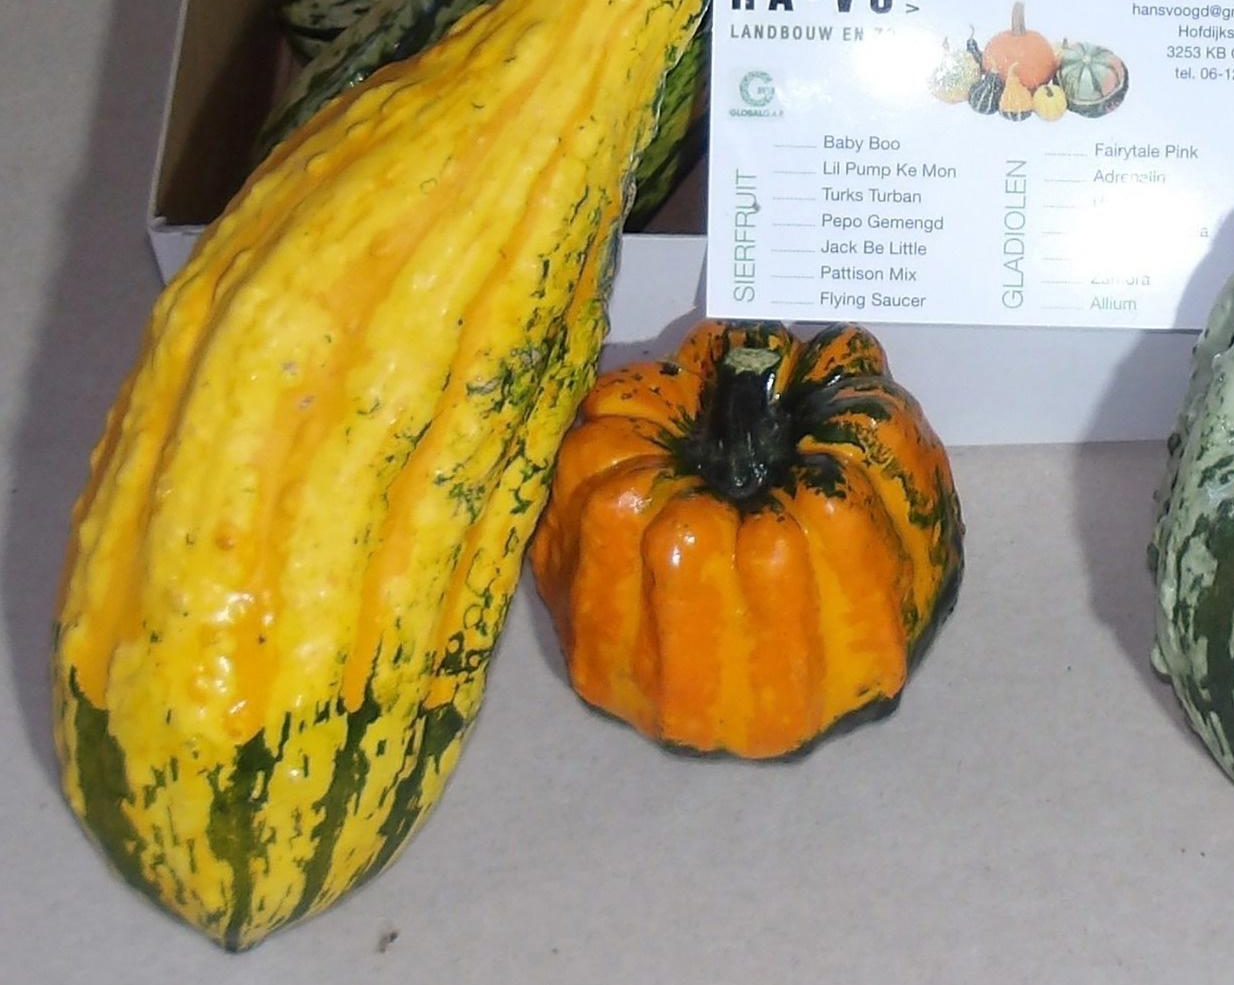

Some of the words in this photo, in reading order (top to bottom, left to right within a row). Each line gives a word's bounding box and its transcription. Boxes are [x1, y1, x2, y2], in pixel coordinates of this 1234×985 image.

[730, 24, 833, 41] LANDBOUW
[843, 27, 864, 41] EN
[1167, 46, 1201, 58] 3253
[1206, 47, 1226, 59] KB
[1175, 68, 1195, 79] tel.
[823, 135, 864, 152] Baby
[869, 136, 901, 150] Boo
[1095, 143, 1160, 161] Fairytale
[1165, 145, 1199, 159] Pink
[823, 161, 840, 175] Lil
[845, 162, 891, 179] Pump
[896, 163, 917, 177] Ke
[922, 164, 957, 178] Mon
[822, 187, 864, 202] Turks
[869, 188, 922, 203] Turban
[822, 214, 863, 230] Pepo
[868, 215, 944, 233] Gemengd
[733, 168, 757, 302] SIERFRUIT
[1001, 160, 1027, 309] GLADIOLEN
[821, 240, 857, 254] Jack
[864, 241, 884, 255] Be
[889, 242, 927, 256] Little
[820, 266, 884, 281] Pattison
[889, 267, 917, 281] Mix
[820, 292, 865, 309] Flying
[872, 293, 926, 307] Saucer
[1089, 296, 1137, 311] Allium
